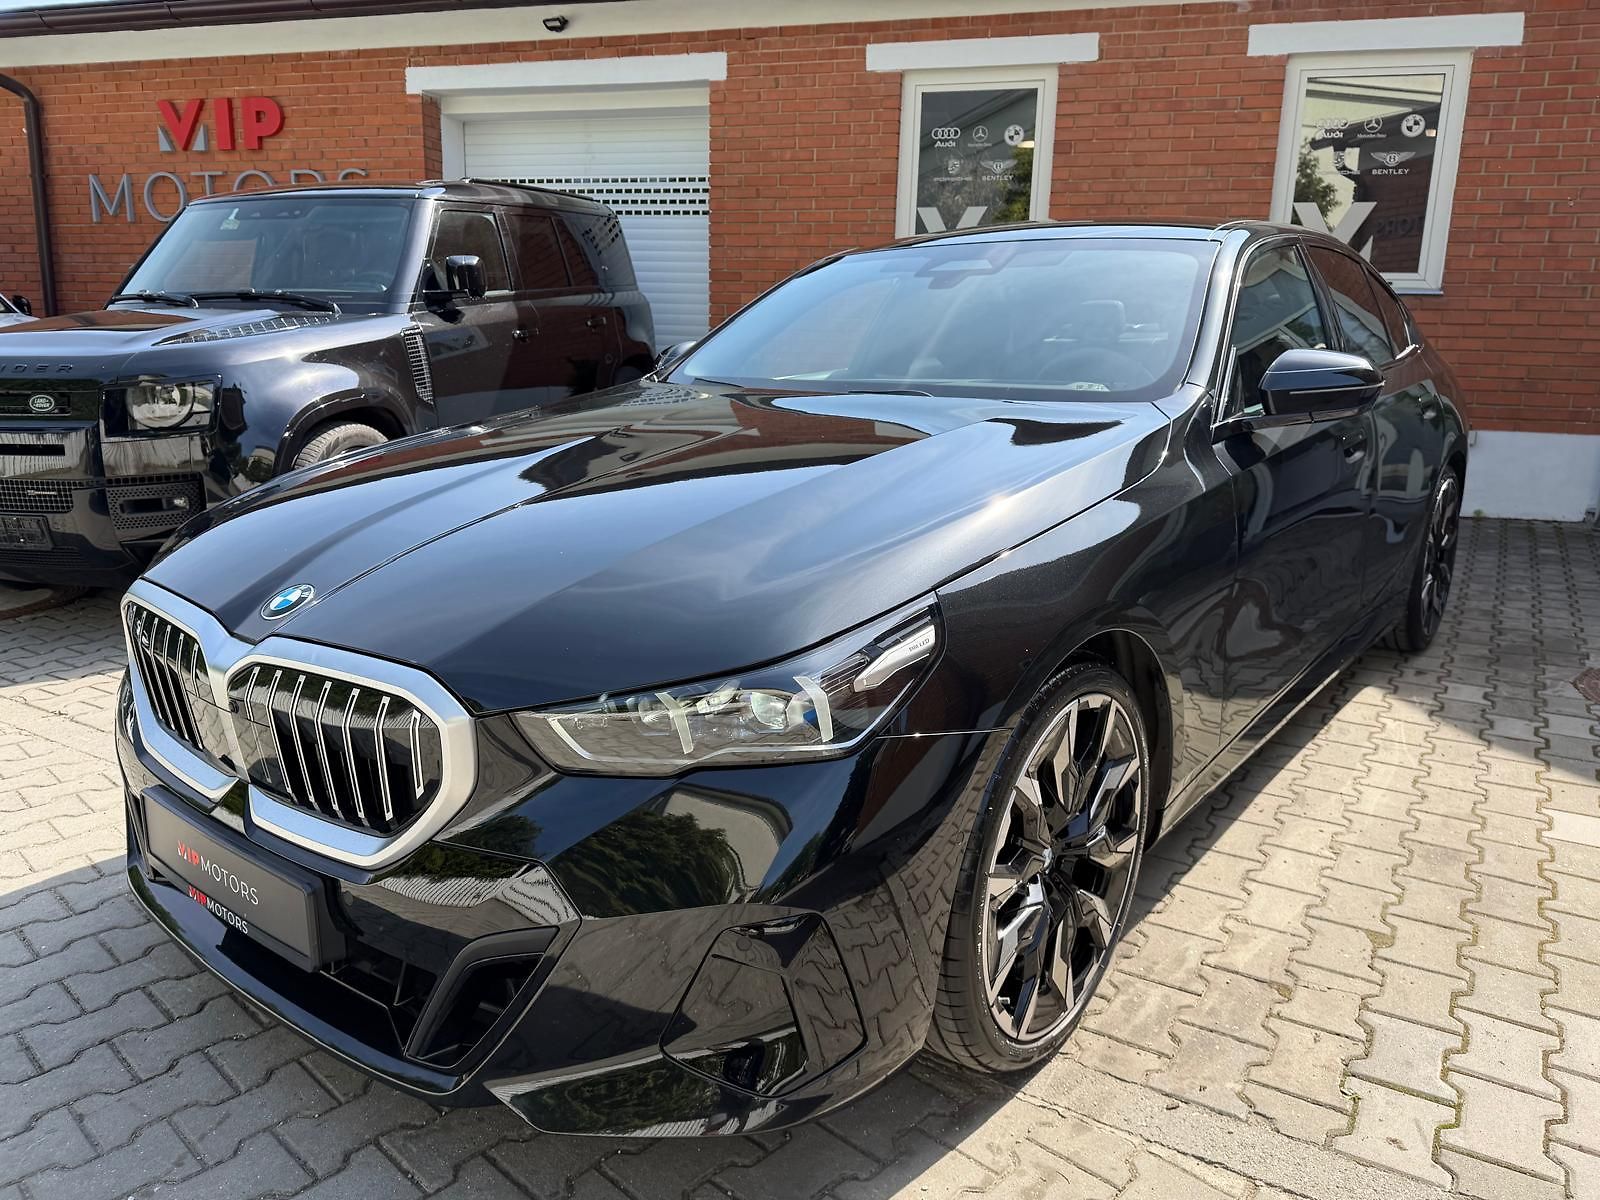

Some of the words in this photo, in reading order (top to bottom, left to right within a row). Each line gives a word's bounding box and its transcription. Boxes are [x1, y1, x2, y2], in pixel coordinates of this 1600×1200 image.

[156, 96, 285, 152] VIP
[934, 140, 956, 148] Audi
[88, 168, 368, 223] MOT
[177, 840, 199, 866] VIP
[201, 855, 259, 905] MOTORS
[188, 885, 207, 905] VIP
[206, 897, 248, 935] MOTORS
